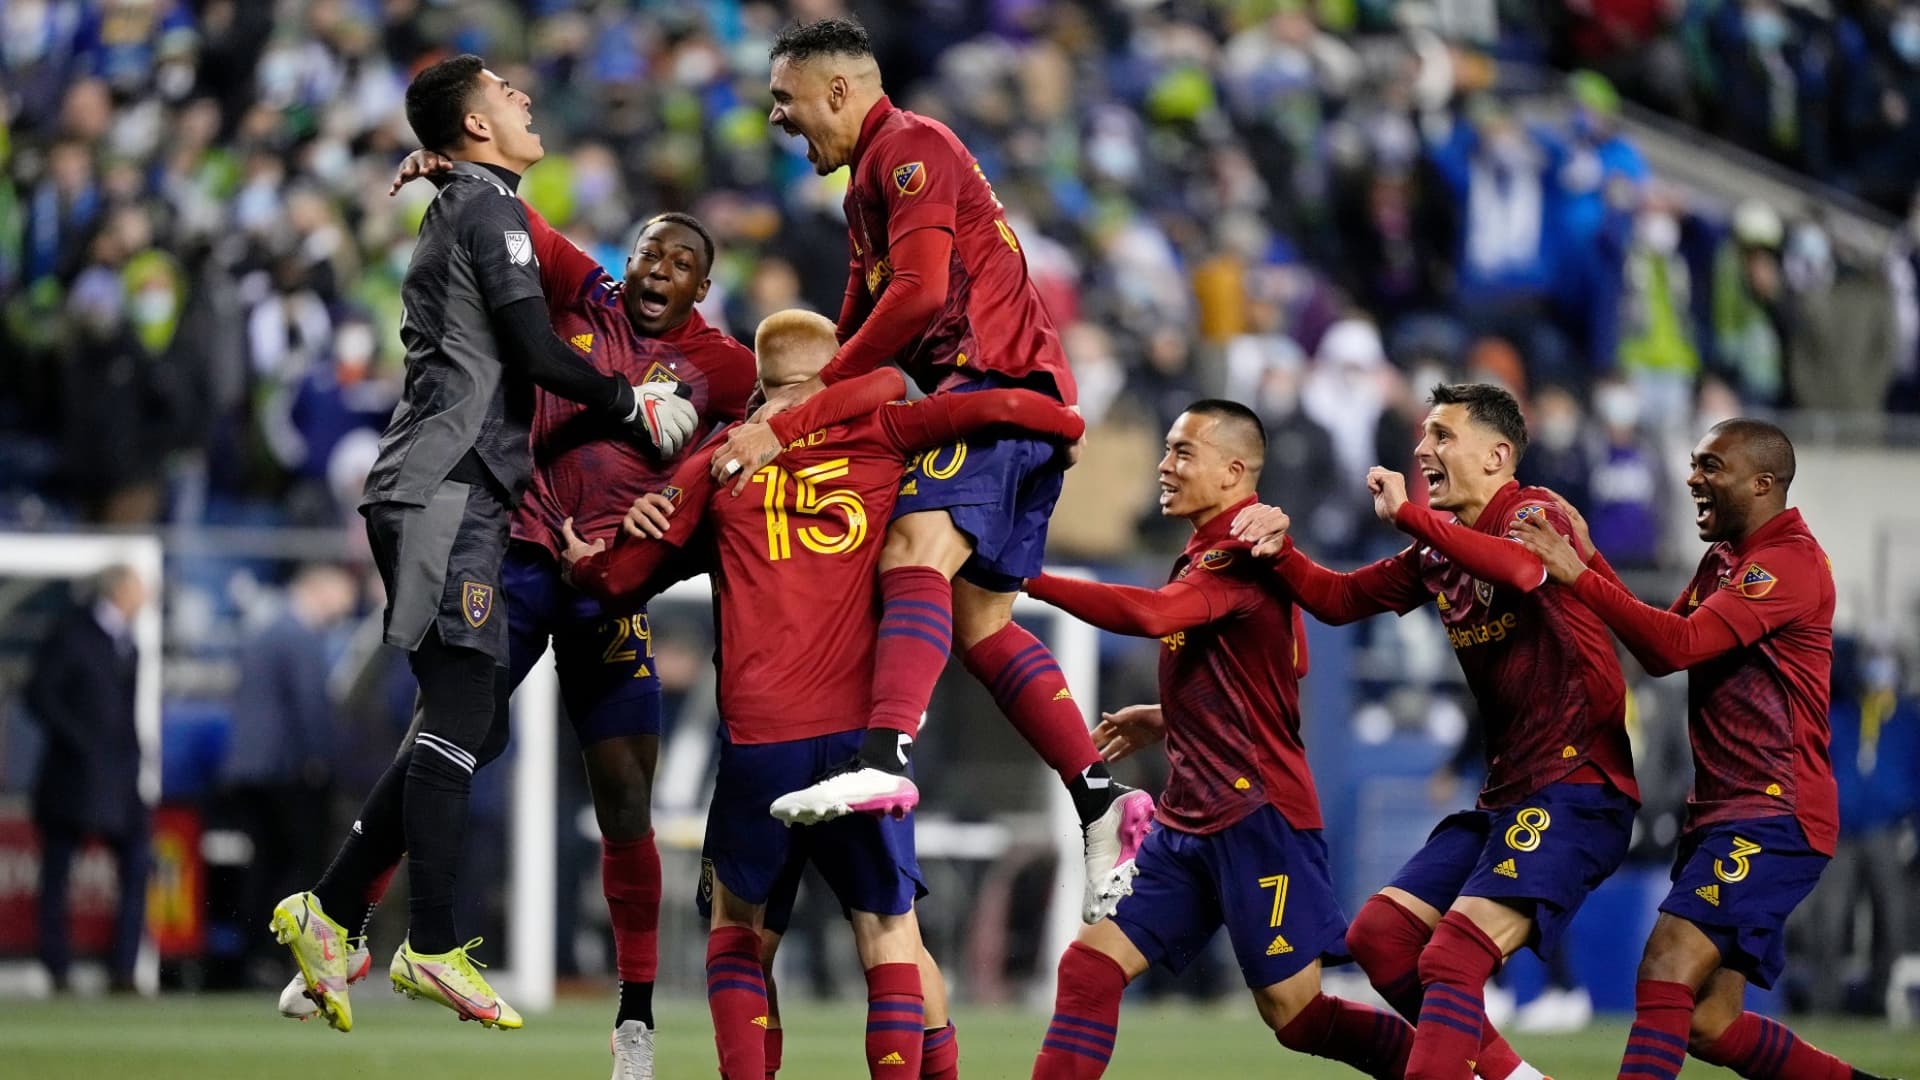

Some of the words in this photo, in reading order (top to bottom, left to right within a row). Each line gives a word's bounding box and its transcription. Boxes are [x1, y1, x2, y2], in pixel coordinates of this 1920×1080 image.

[752, 457, 867, 561] 15
[601, 613, 656, 664] 29
[1505, 807, 1551, 852] 8
[1713, 836, 1762, 884] 3
[1258, 874, 1289, 928] 7
[1265, 945, 1294, 956] adidas
